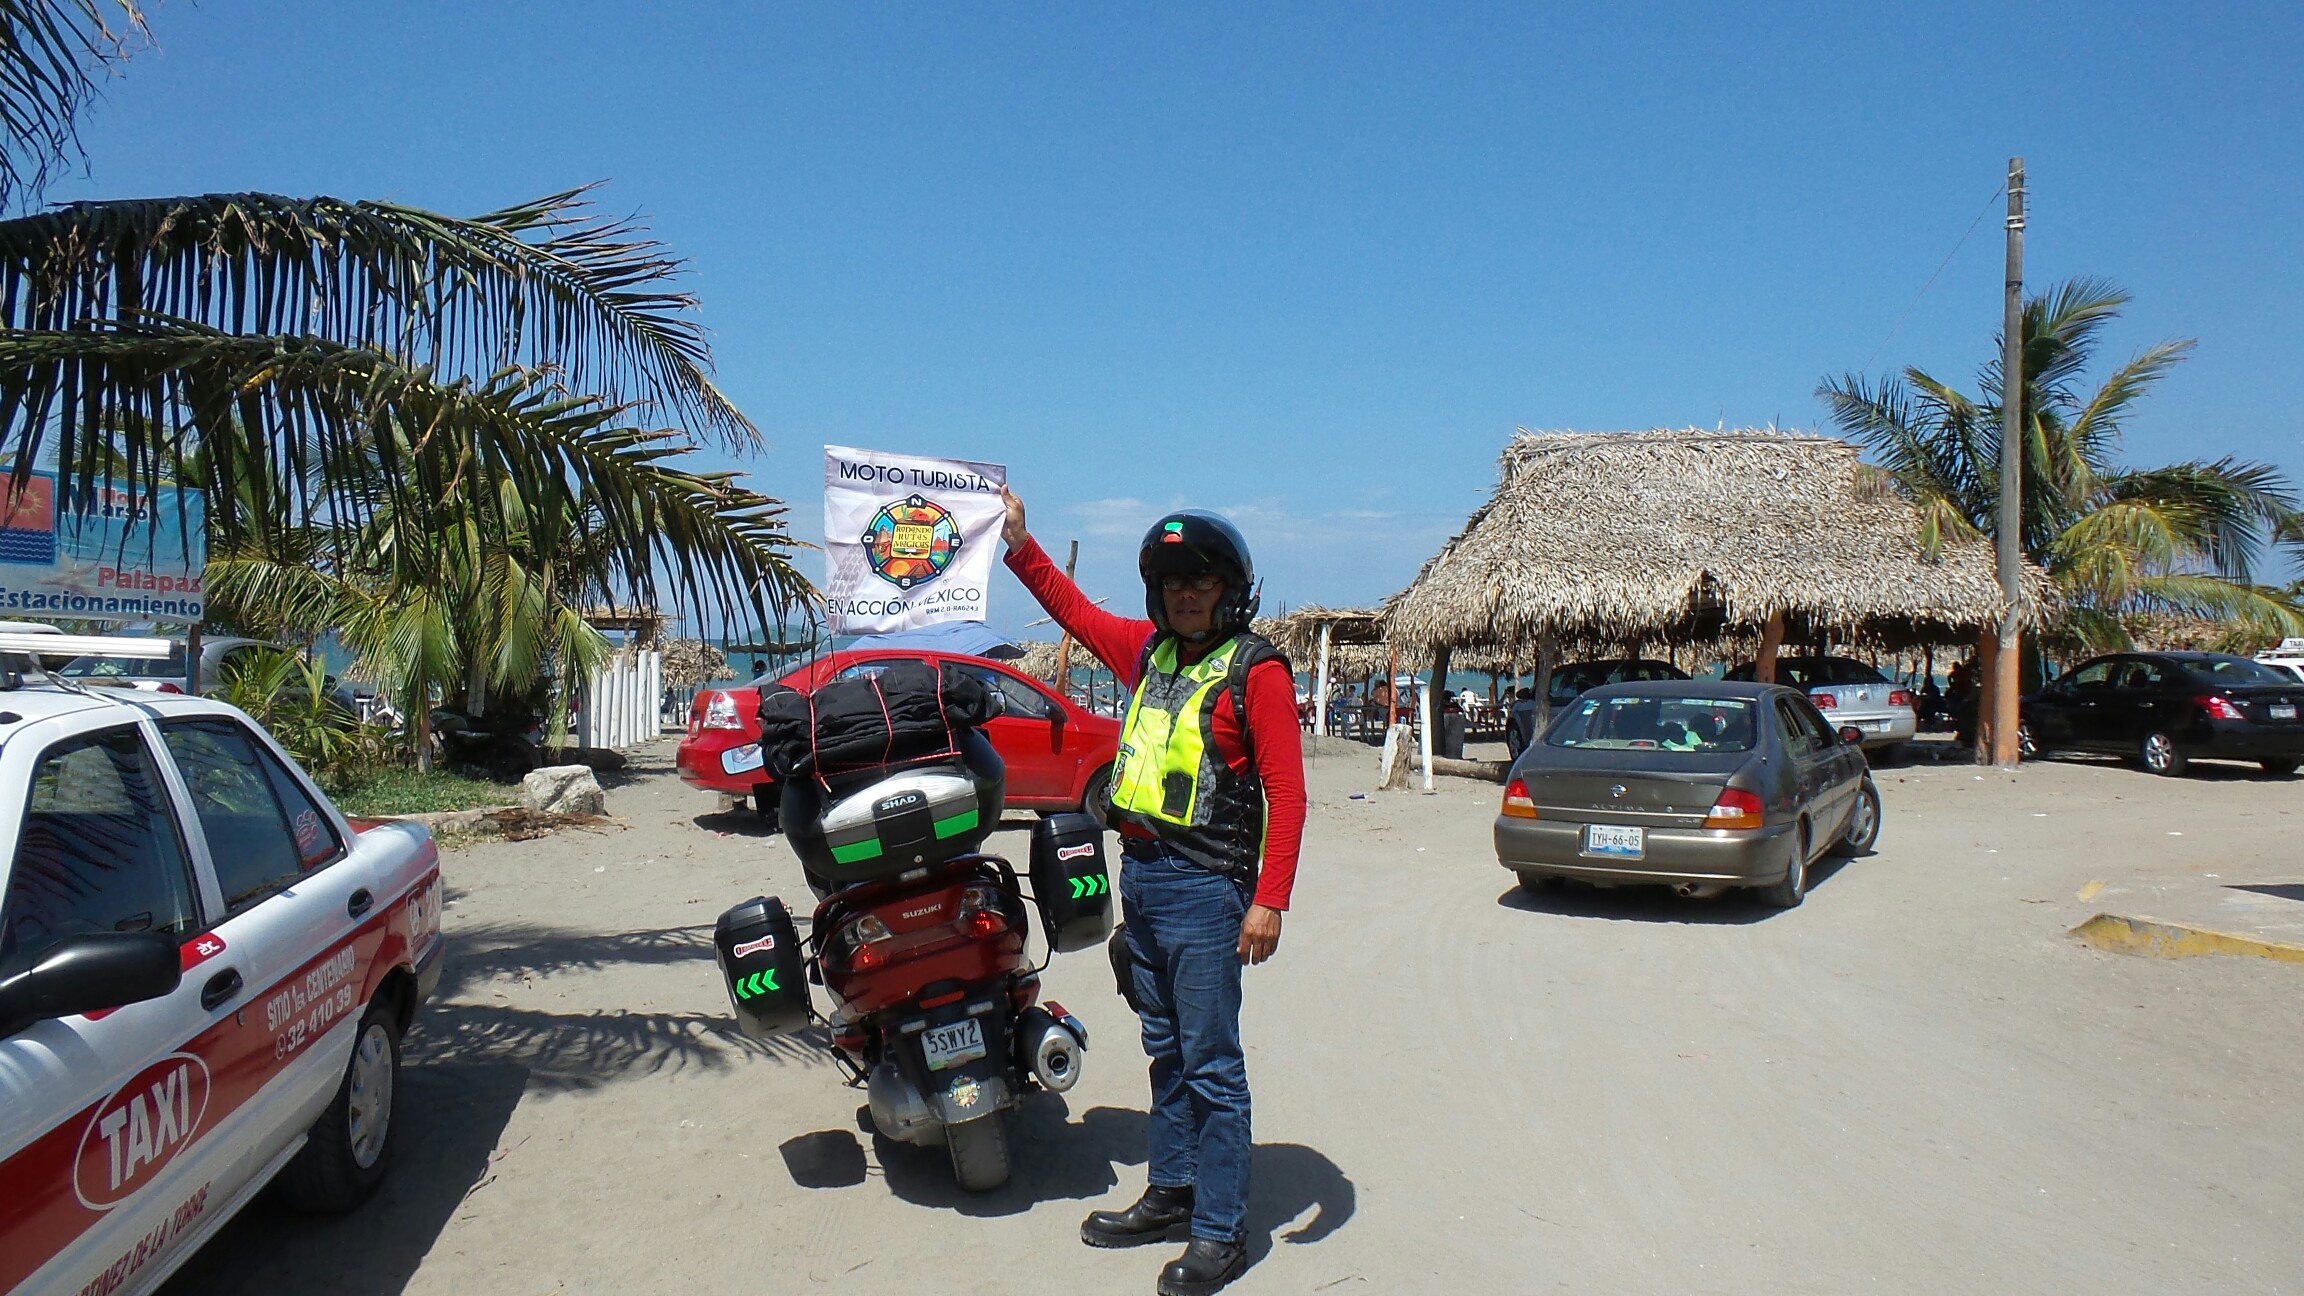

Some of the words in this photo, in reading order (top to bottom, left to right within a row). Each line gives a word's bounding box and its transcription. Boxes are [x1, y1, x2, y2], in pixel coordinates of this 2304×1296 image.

[840, 461, 904, 484] MOTO
[910, 469, 990, 491] TURISTA
[97, 567, 201, 596] Palapas
[901, 578, 911, 587] S
[828, 599, 843, 615] EN
[847, 597, 914, 616] ACCIÓN
[881, 795, 917, 811] SHAD
[1592, 803, 1645, 812] ALTIMA
[1592, 832, 1640, 847] TYH-66-05
[902, 903, 942, 919] SUZUKI
[267, 990, 311, 1032] SITIO
[306, 944, 356, 1002] CENTENARIO
[288, 1018, 305, 1053] 32
[309, 998, 333, 1033] 410
[337, 983, 352, 1013] 39
[927, 1024, 979, 1054] 5SWY2
[100, 1063, 189, 1191] TAXI
[129, 1231, 153, 1275] DE
[148, 1217, 169, 1259] LA
